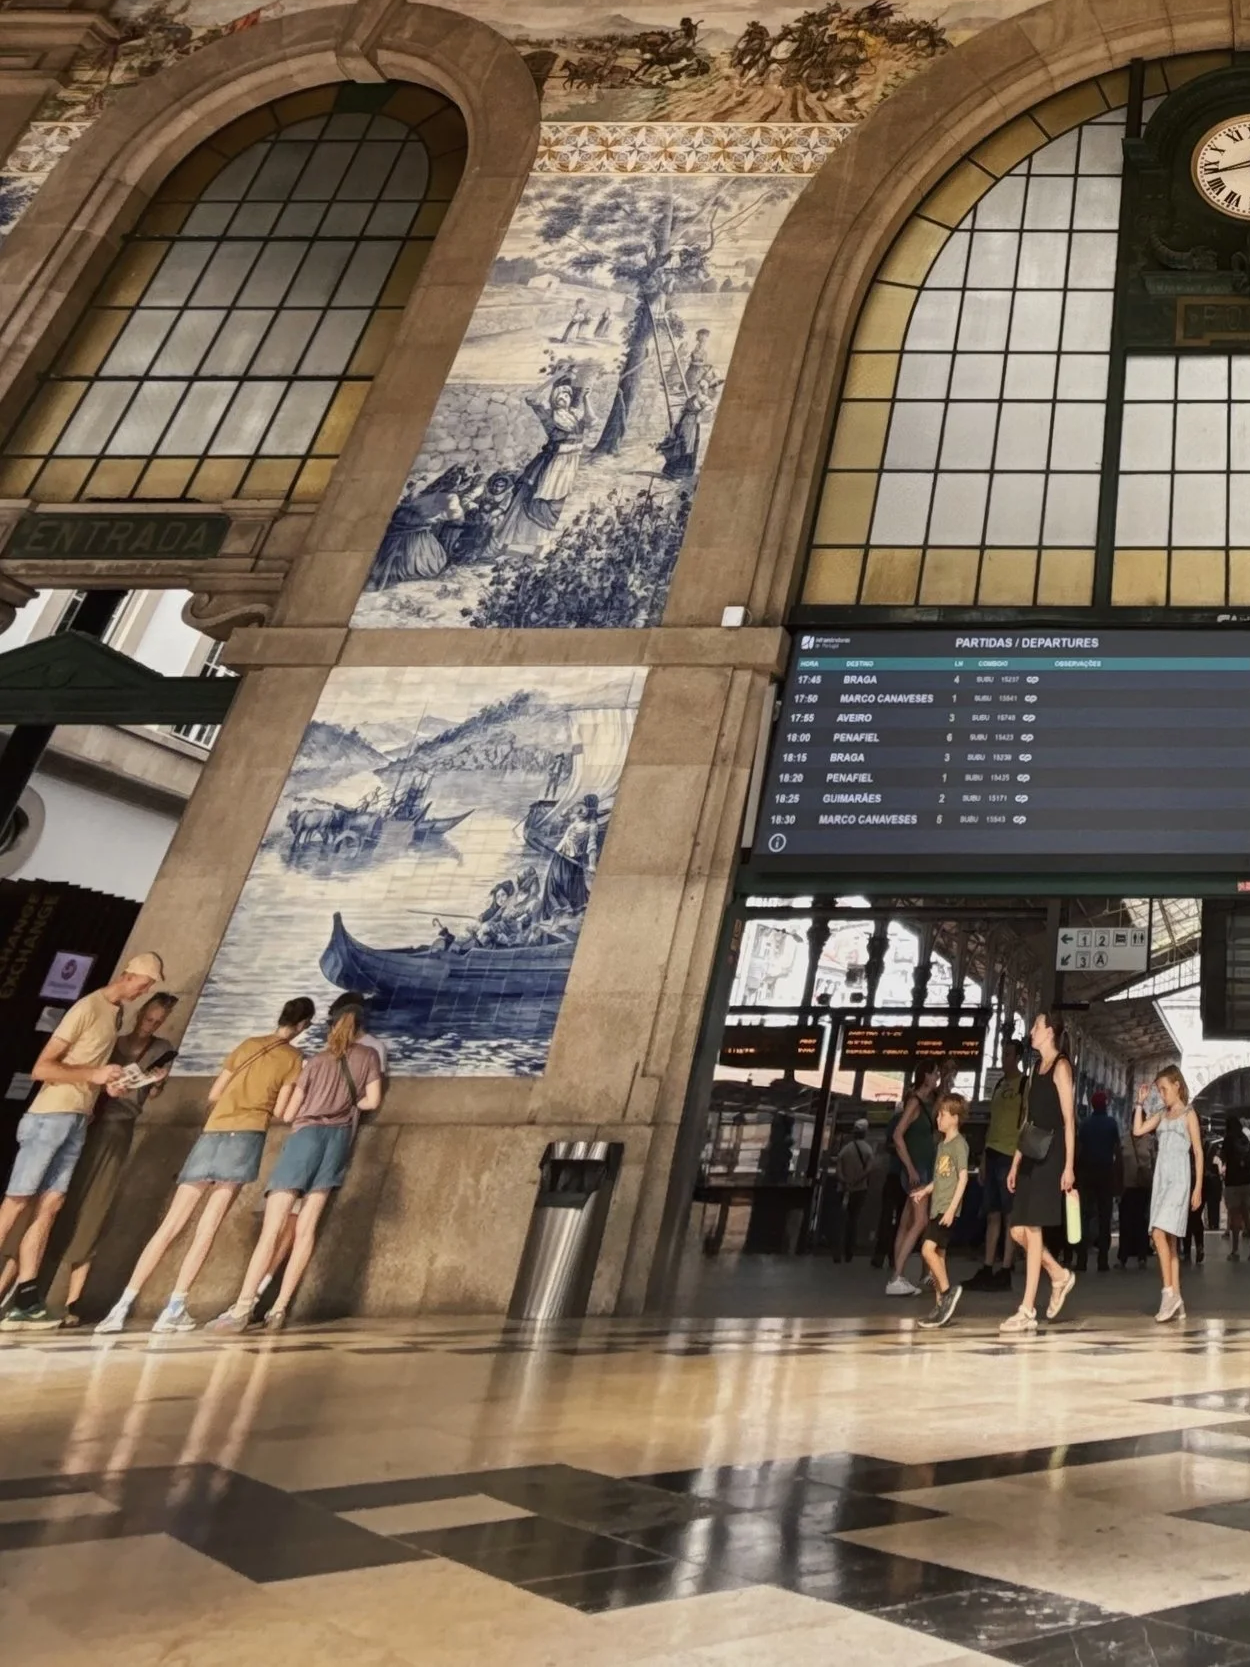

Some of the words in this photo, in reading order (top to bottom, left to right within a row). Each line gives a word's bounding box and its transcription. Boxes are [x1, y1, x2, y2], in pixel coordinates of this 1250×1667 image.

[1225, 129, 1244, 143] XI
[1210, 141, 1226, 156] X
[25, 520, 208, 553] ENTRADA
[955, 637, 1012, 648] PARTIDAS
[1022, 637, 1099, 648] DEPARTURES
[1054, 659, 1101, 668] OBSERVAÇÕES
[798, 675, 821, 684] 17:45
[843, 675, 877, 684] BRAGA
[840, 694, 874, 703] MARCO
[877, 694, 934, 703] CANAVESES
[836, 713, 872, 722] AVEIRO
[787, 733, 811, 742] 18:00
[833, 733, 880, 742] PENAFIEL
[783, 753, 807, 762] 18:15
[830, 753, 864, 762] BRAGA
[779, 773, 803, 783] 18:20
[826, 773, 873, 783] PENAFIEL
[775, 794, 799, 803] 18:25
[823, 792, 881, 803] GUIMARÃES
[771, 815, 795, 824] 18:30
[819, 815, 856, 824] MARCO
[858, 815, 917, 824] CANAVESES
[1082, 936, 1087, 946] 1
[1099, 935, 1105, 946] 2
[1, 894, 60, 998] EXCHANGE
[1080, 957, 1086, 967] 3
[1096, 954, 1104, 964] A
